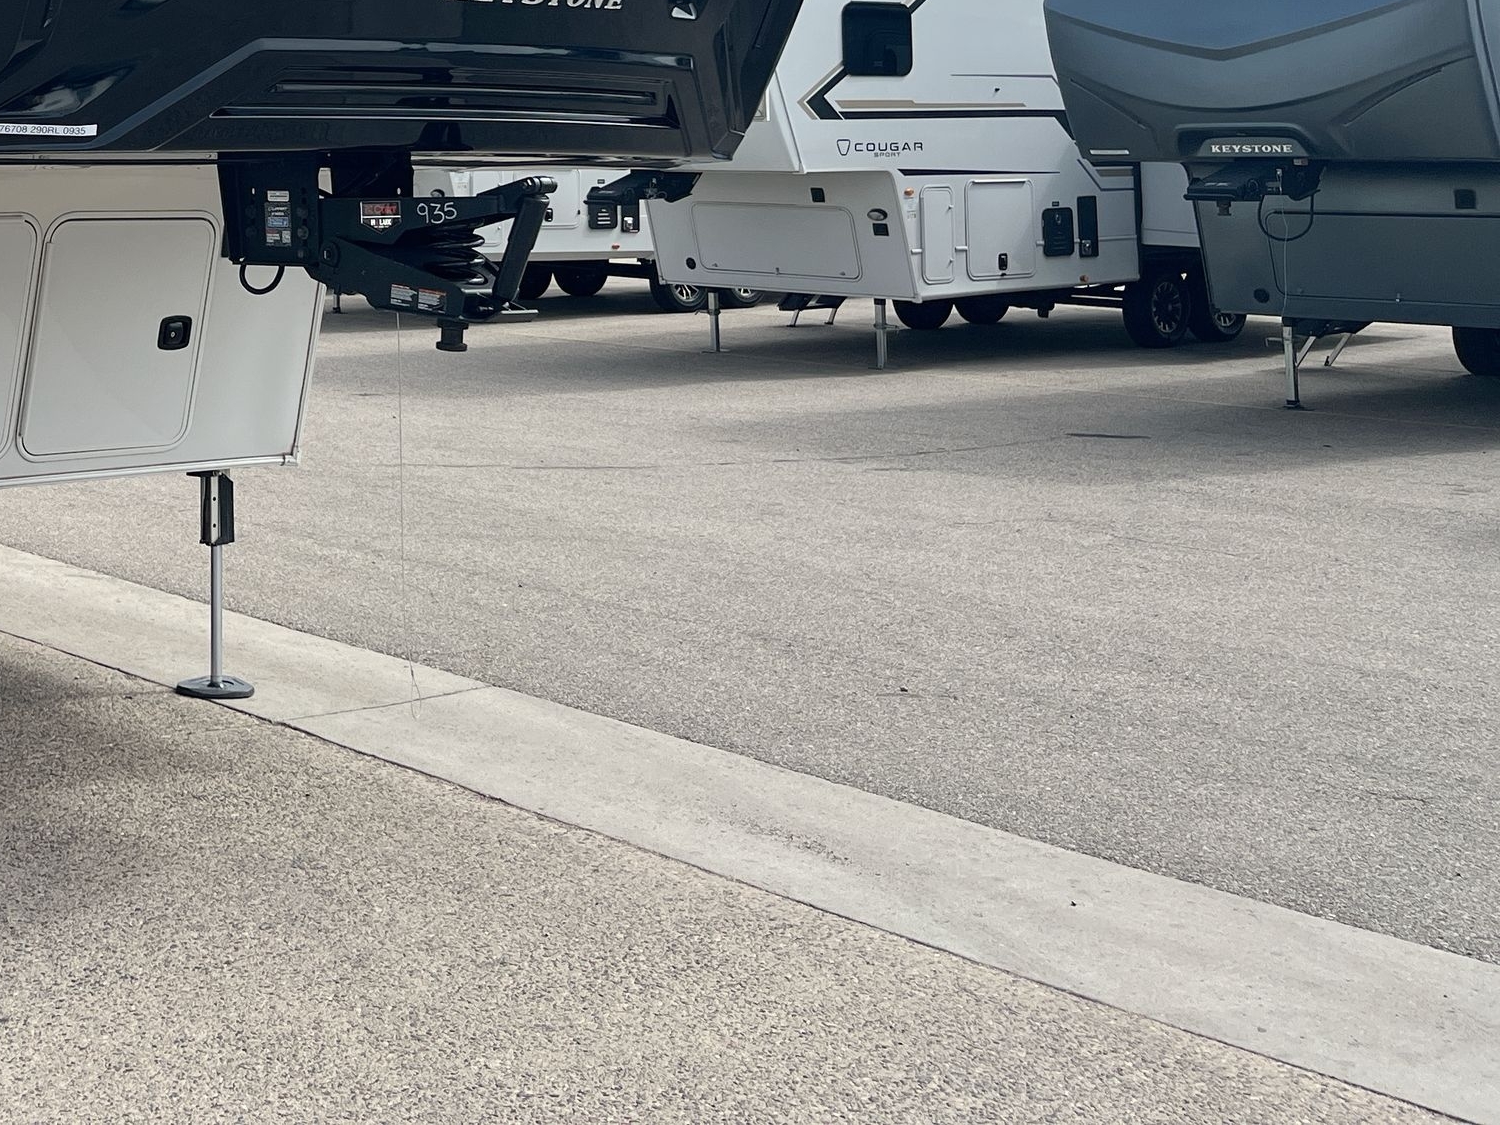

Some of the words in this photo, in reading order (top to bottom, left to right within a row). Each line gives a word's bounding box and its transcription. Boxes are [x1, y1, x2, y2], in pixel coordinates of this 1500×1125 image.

[30, 125, 61, 134] 290RL
[63, 127, 87, 135] 0935
[854, 142, 924, 152] COUGAR
[1211, 144, 1293, 153] KEYSTONE
[417, 201, 458, 224] 935
